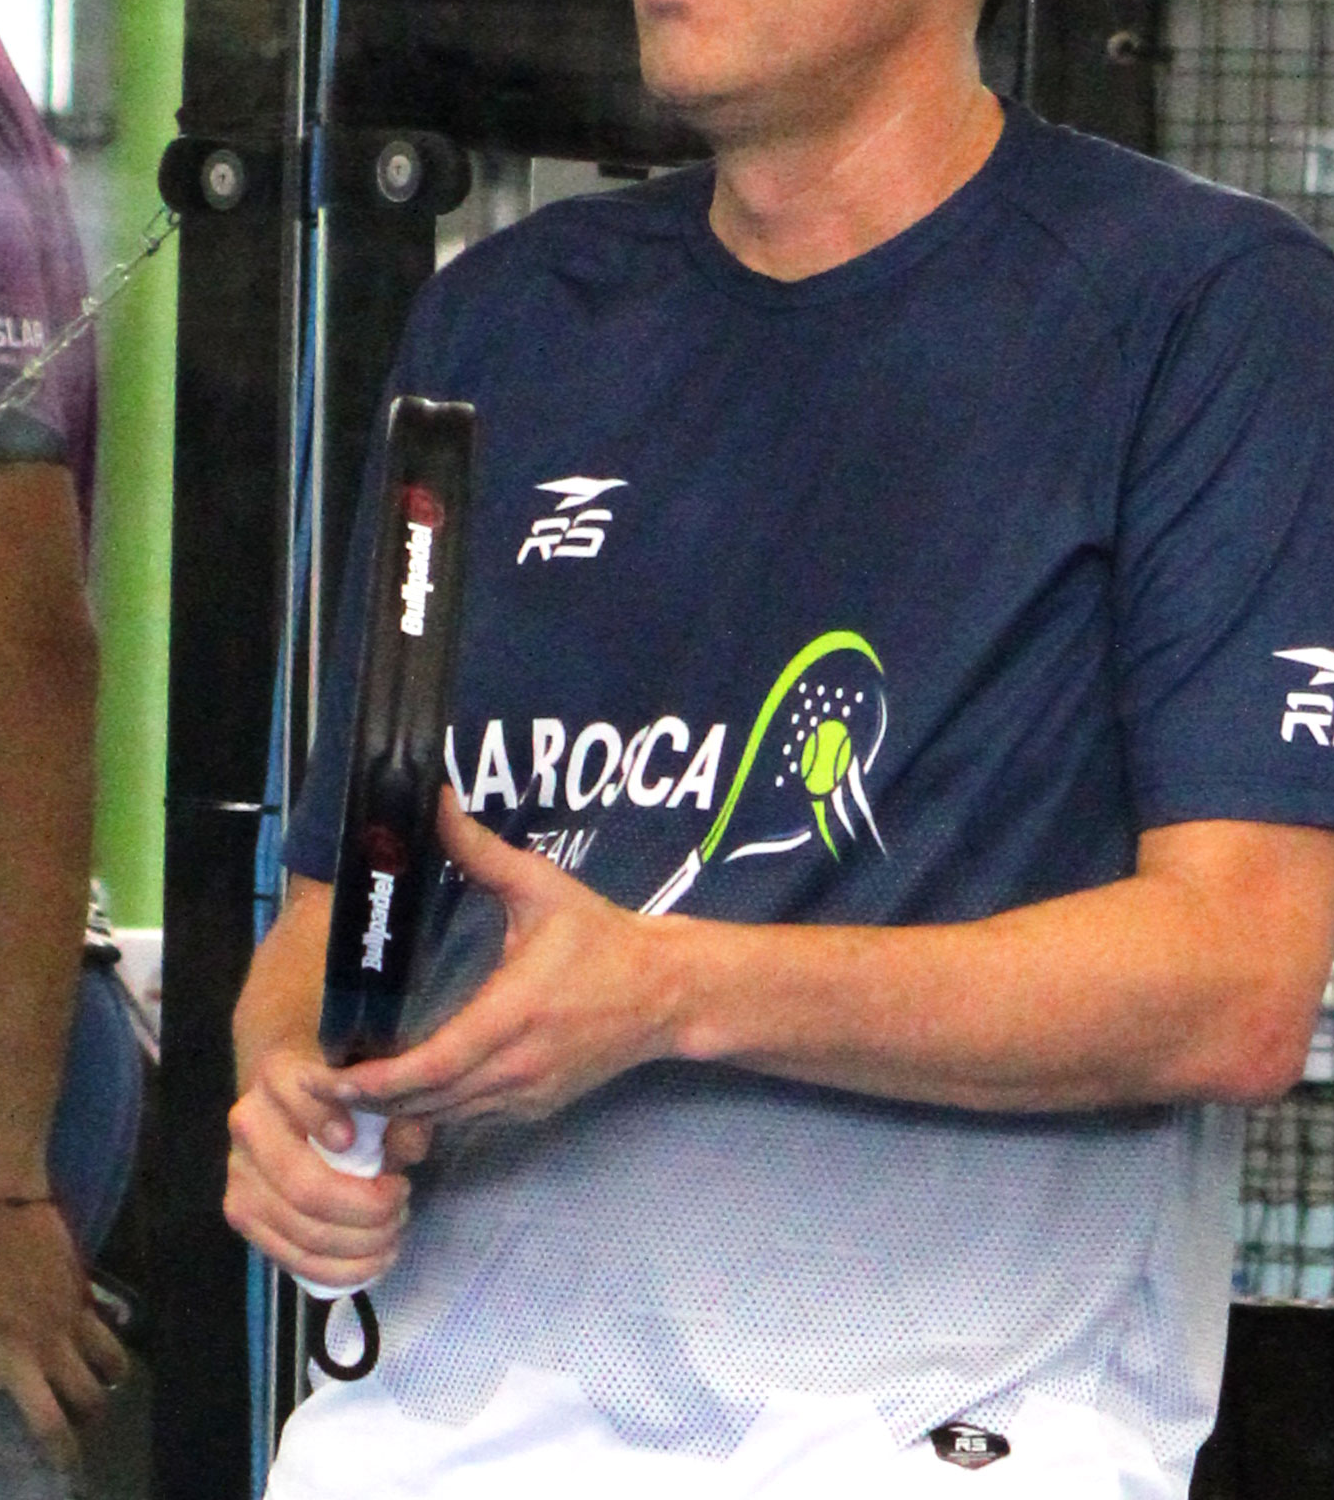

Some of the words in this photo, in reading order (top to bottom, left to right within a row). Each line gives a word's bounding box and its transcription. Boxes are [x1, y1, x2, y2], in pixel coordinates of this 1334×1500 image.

[400, 520, 435, 637] Bullpadel
[516, 508, 614, 565] RS
[361, 869, 396, 973] Bullpadel
